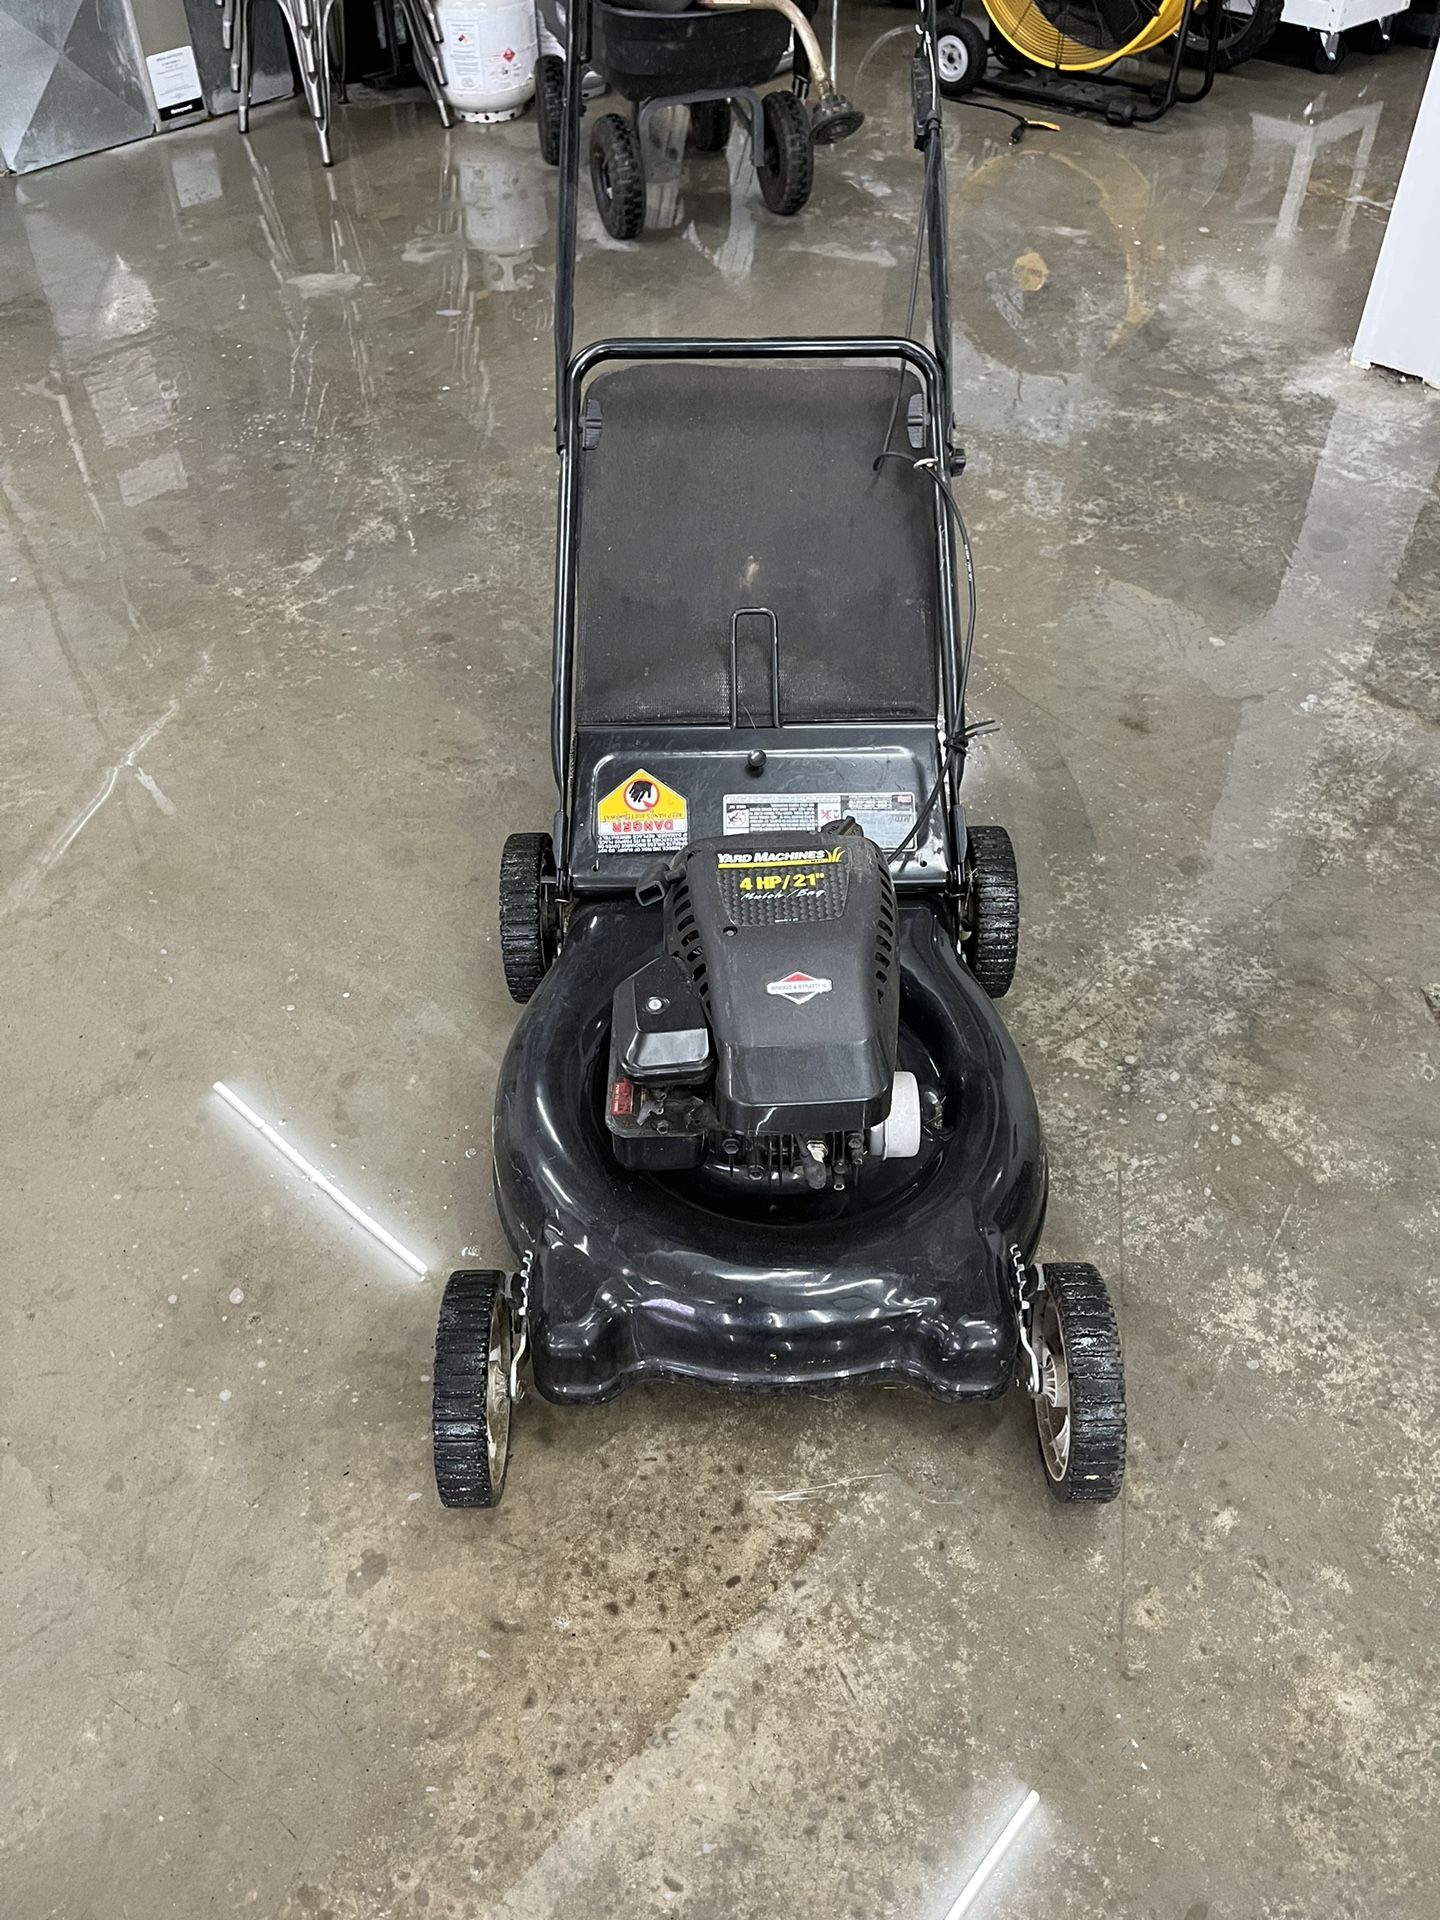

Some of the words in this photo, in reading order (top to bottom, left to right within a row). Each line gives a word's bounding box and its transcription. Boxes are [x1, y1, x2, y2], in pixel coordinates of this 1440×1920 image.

[612, 820, 673, 832] DANGER
[717, 853, 752, 863] YARD
[754, 850, 825, 862] MACHINES
[739, 877, 752, 891] 4
